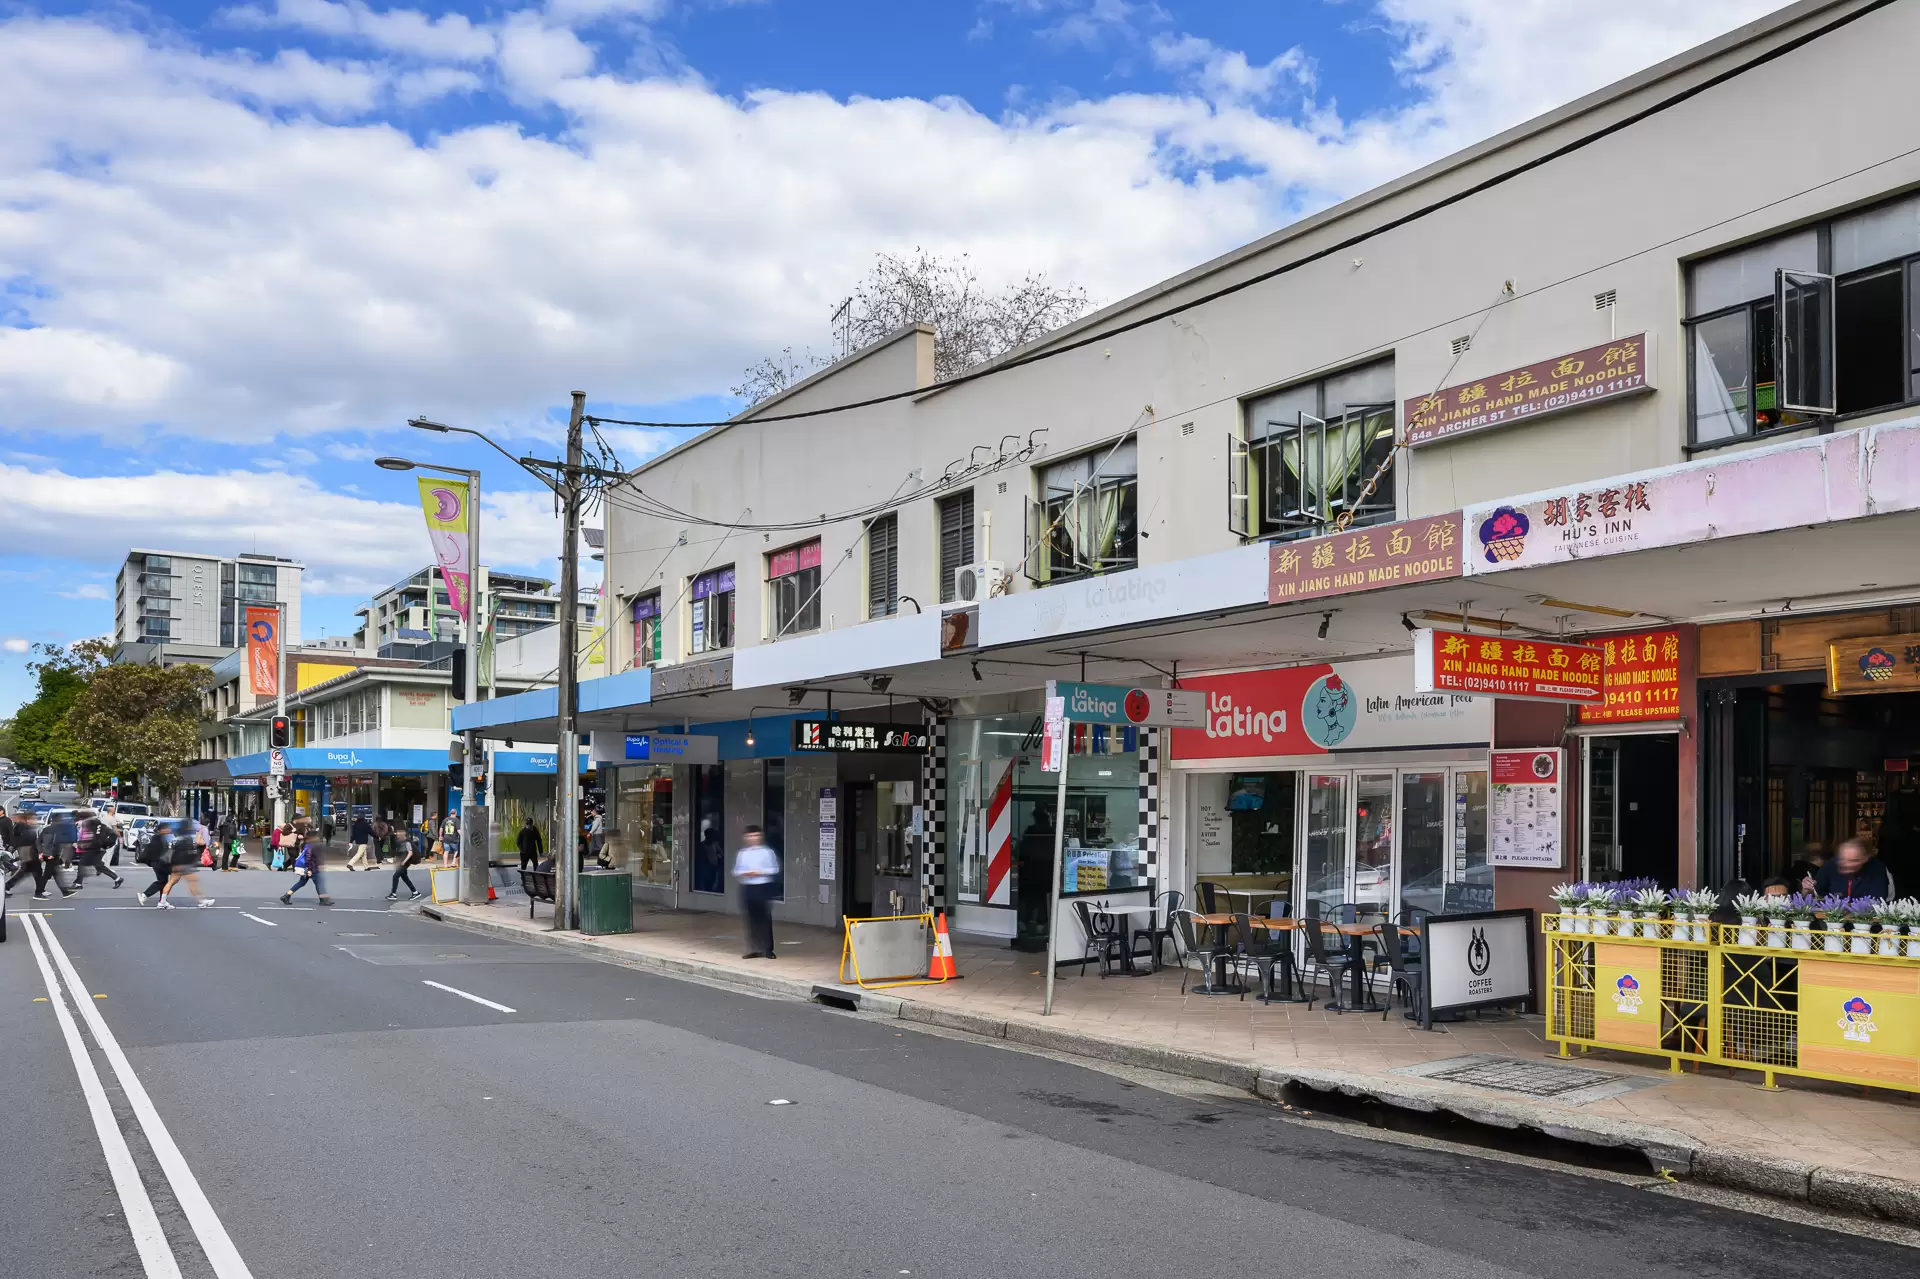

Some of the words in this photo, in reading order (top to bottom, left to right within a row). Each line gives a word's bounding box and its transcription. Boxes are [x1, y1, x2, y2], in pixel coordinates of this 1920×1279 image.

[1416, 416, 1437, 428] XIN
[1441, 404, 1480, 422] JIANG
[1486, 393, 1523, 410] HAND
[1528, 380, 1568, 399] MADE
[1574, 362, 1637, 387] NOODLE
[1412, 430, 1432, 441] 84a
[1438, 415, 1487, 434] ARCHER
[1490, 410, 1506, 420] ST
[1513, 402, 1541, 416] TEL:
[1544, 384, 1604, 409] (02)9410
[1608, 374, 1642, 391] 1117
[1563, 526, 1598, 541] HU'S
[1605, 520, 1632, 534] INN
[1554, 539, 1600, 552] TAIWANESE
[1604, 532, 1640, 545] CUISINE
[192, 565, 203, 606] QUEST
[1278, 583, 1296, 598] XIN
[1299, 578, 1330, 594] JIANG
[1334, 573, 1365, 588] HAND
[1368, 565, 1400, 582] MADE
[1404, 556, 1453, 577] NOODLE
[1586, 635, 1679, 666] 疆拉面館
[1443, 660, 1462, 672] XIN
[1466, 662, 1498, 674] JIANG
[1502, 665, 1529, 678] HAND
[1532, 668, 1559, 681] MADE
[1562, 671, 1599, 684] NOODLE
[1614, 672, 1630, 686] HAND
[1632, 670, 1650, 684] MADE
[1652, 668, 1676, 682] NOODLE
[1440, 675, 1462, 687] TEL:
[1464, 676, 1506, 690] (02)9410
[1508, 680, 1529, 692] 1117
[1366, 696, 1390, 713] Latin
[1395, 694, 1444, 711] American
[1646, 688, 1678, 702] 1117
[1616, 708, 1642, 716] PLEASE
[1645, 706, 1680, 715] UPSTAIRS
[832, 726, 874, 738] 哈利发型
[884, 731, 926, 747] Salon
[1469, 978, 1492, 988] COFFEE
[1469, 987, 1492, 995] ROASTERS
